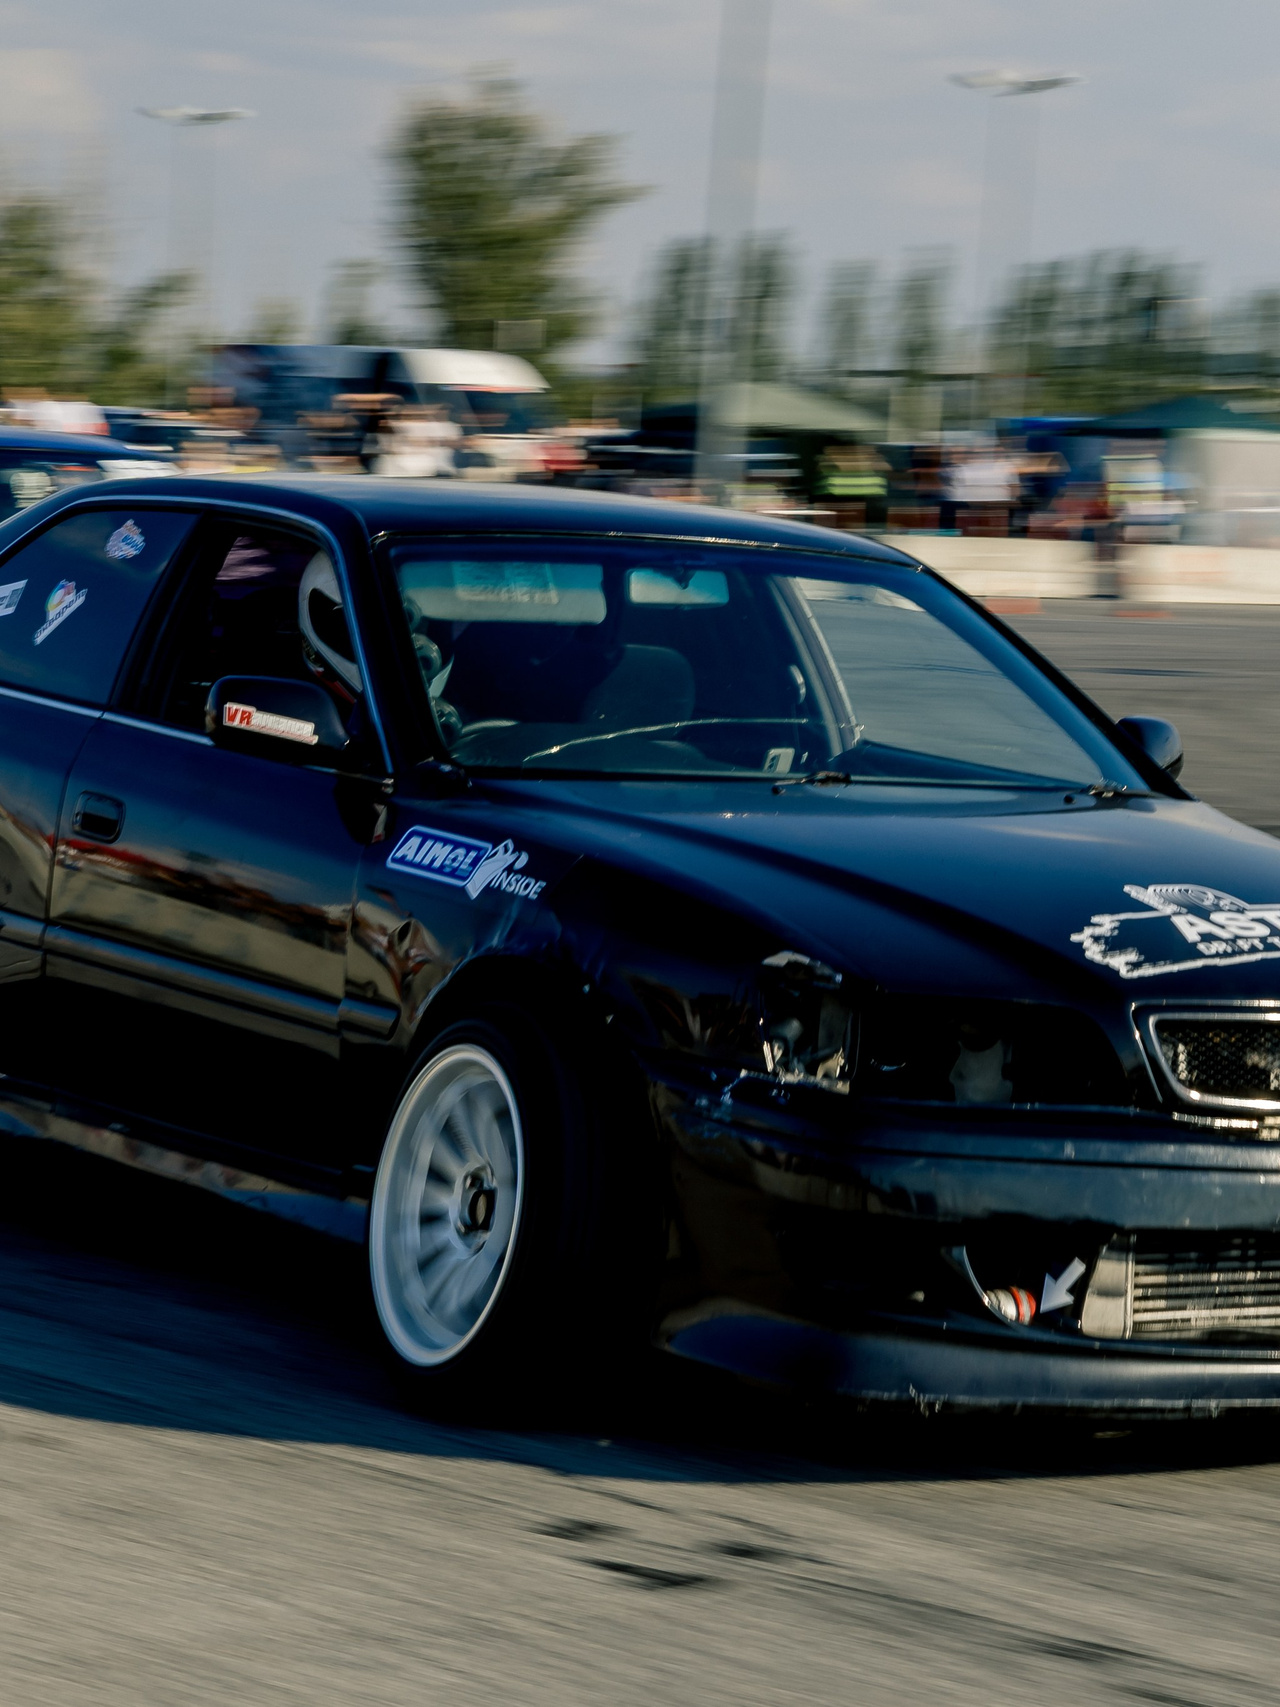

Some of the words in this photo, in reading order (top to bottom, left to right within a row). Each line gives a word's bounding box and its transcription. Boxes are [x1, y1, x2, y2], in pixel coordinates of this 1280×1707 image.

[226, 706, 253, 726] VR
[393, 835, 479, 872] AIMOL
[489, 868, 547, 900] INSIDE
